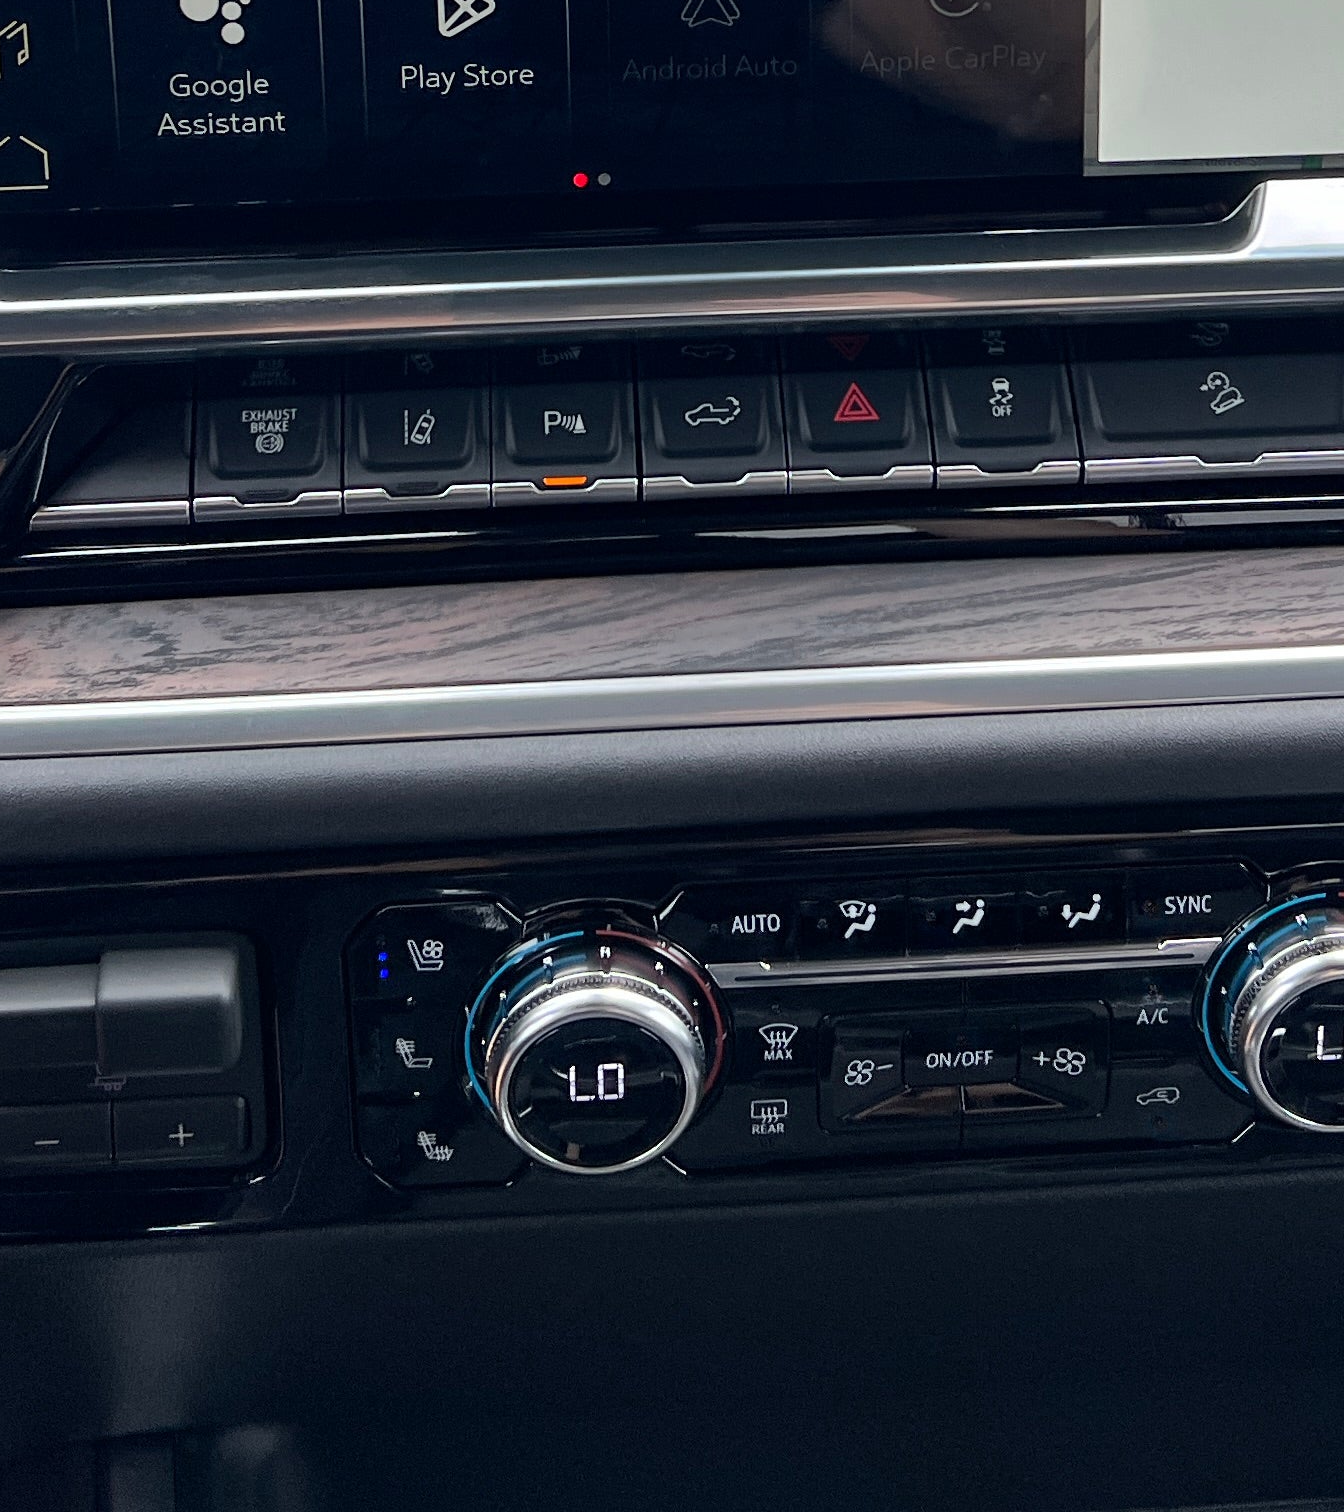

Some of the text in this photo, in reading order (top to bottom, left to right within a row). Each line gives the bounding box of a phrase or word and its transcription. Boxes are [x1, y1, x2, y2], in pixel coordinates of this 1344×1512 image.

[622, 53, 799, 81] Android Auto
[860, 44, 1047, 77] Apple CarPlay
[169, 69, 270, 103] Google
[401, 63, 535, 94] Play Store
[157, 111, 286, 137] Assistant
[242, 408, 297, 422] EXHAUST
[992, 405, 1012, 417] OFF
[250, 420, 289, 433] BRAKE
[1164, 894, 1212, 915] SYNC
[731, 913, 781, 934] AUTO
[1136, 1007, 1168, 1025] A/C
[764, 1048, 793, 1061] MAX
[925, 1049, 994, 1069] ON/OFF
[751, 1121, 785, 1135] REAR
